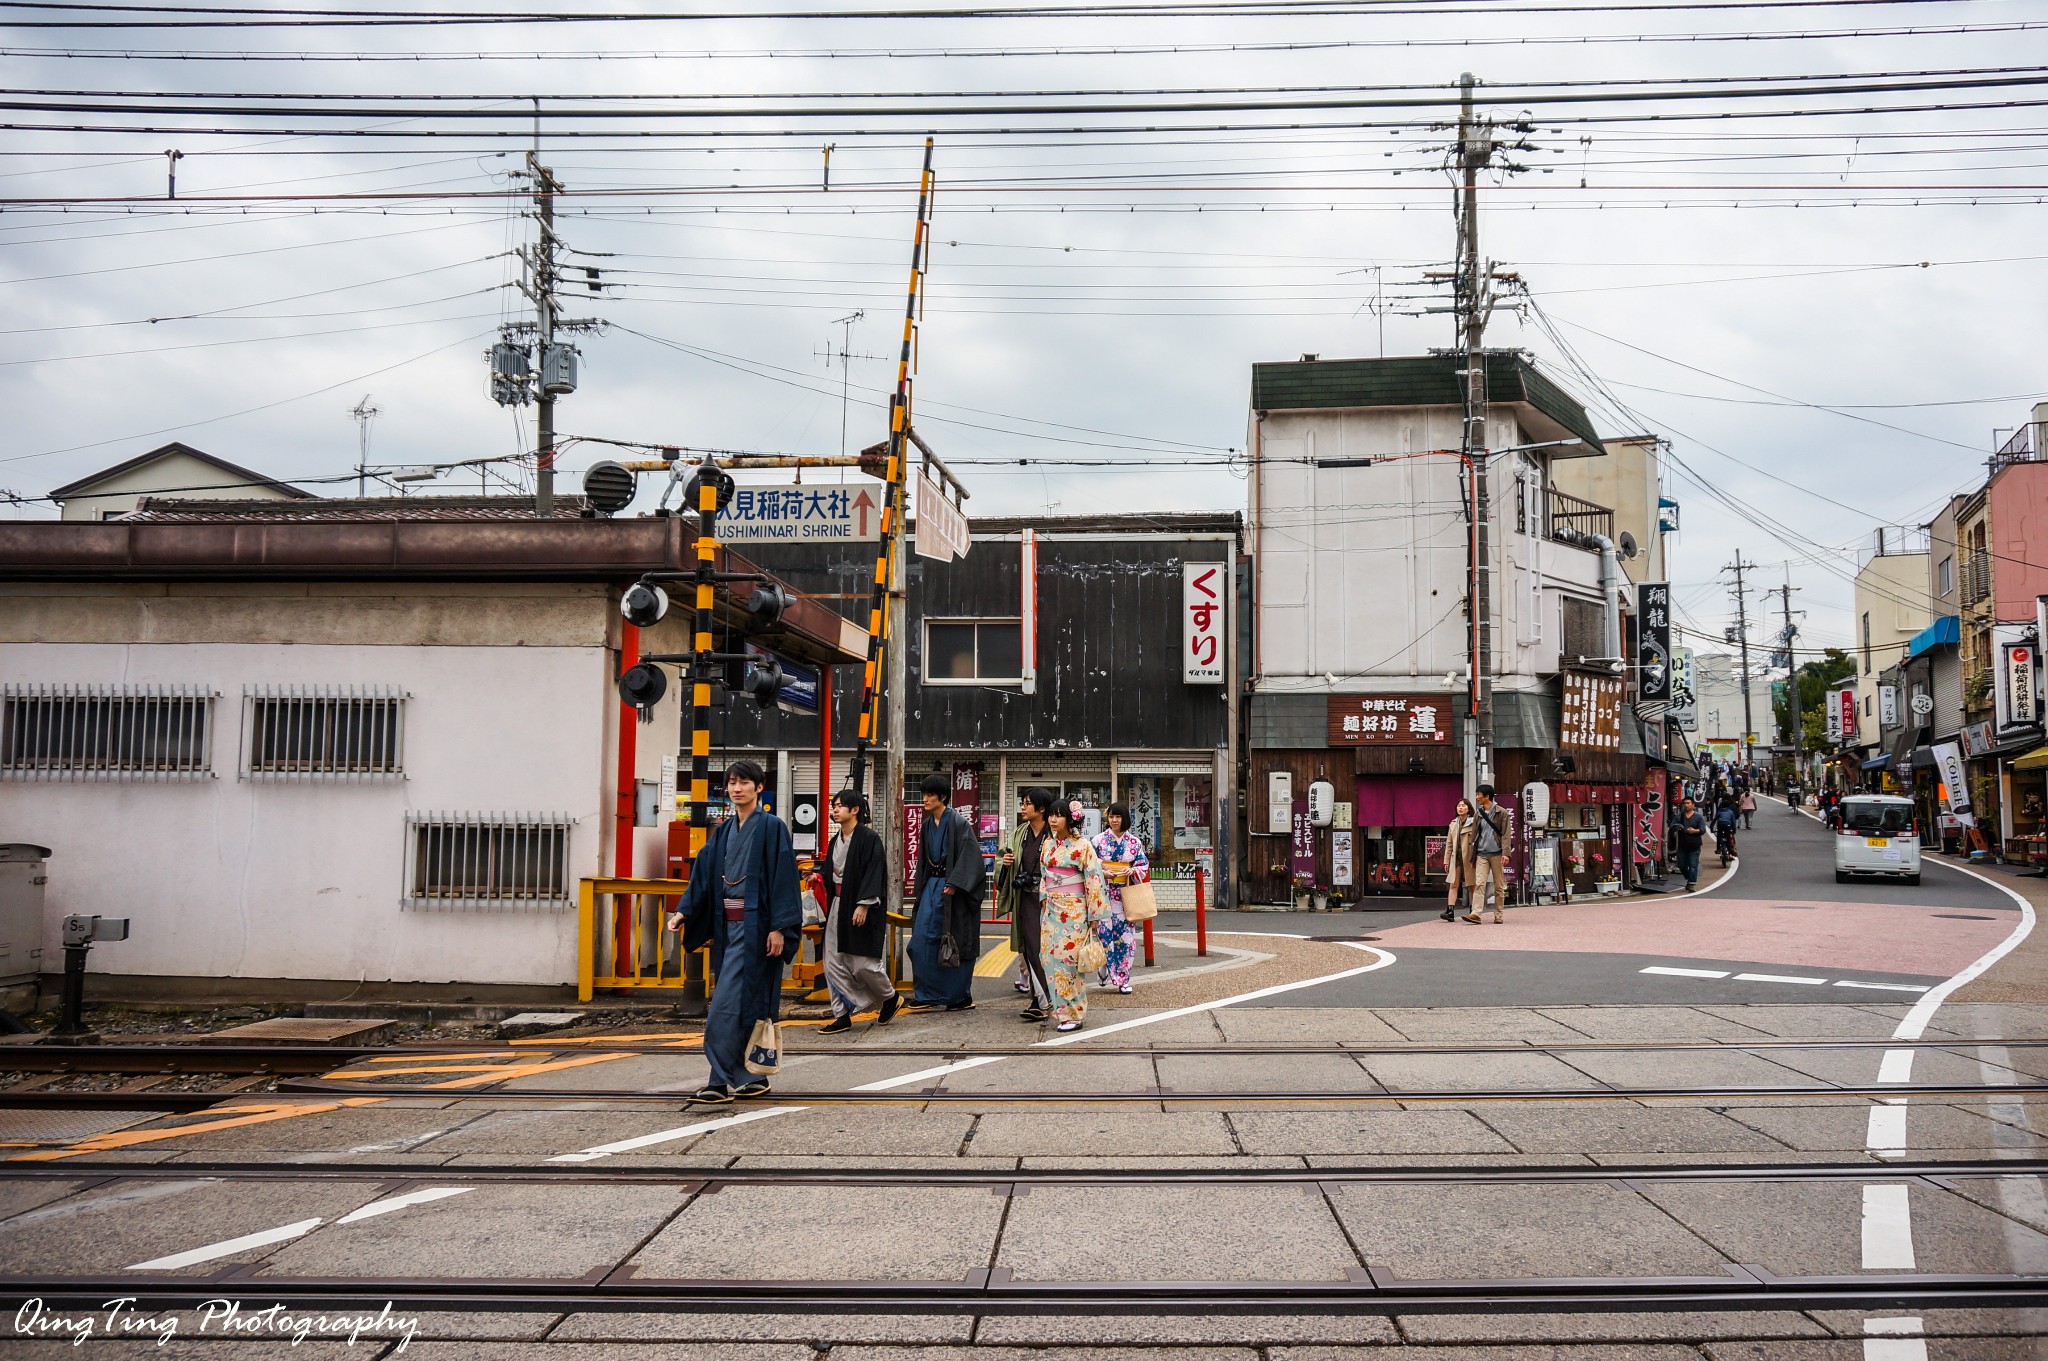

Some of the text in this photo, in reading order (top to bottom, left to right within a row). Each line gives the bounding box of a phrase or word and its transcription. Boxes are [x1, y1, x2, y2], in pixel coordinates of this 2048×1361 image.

[803, 524, 851, 537] SHRINE
[1189, 568, 1219, 666] くすり
[1646, 587, 1668, 628] 翔龍
[1362, 699, 1407, 712] 中華そば
[2014, 663, 2031, 720] 稲荷煎餅発祥
[1343, 705, 1437, 733] 麺好坊 蓮
[1843, 701, 1853, 733] あかね屋
[1884, 704, 1894, 722] フルタ
[1945, 755, 1964, 806] COFFEE
[1294, 813, 1303, 848] あります。
[1177, 863, 1196, 872] トノス
[70, 919, 85, 932] S5
